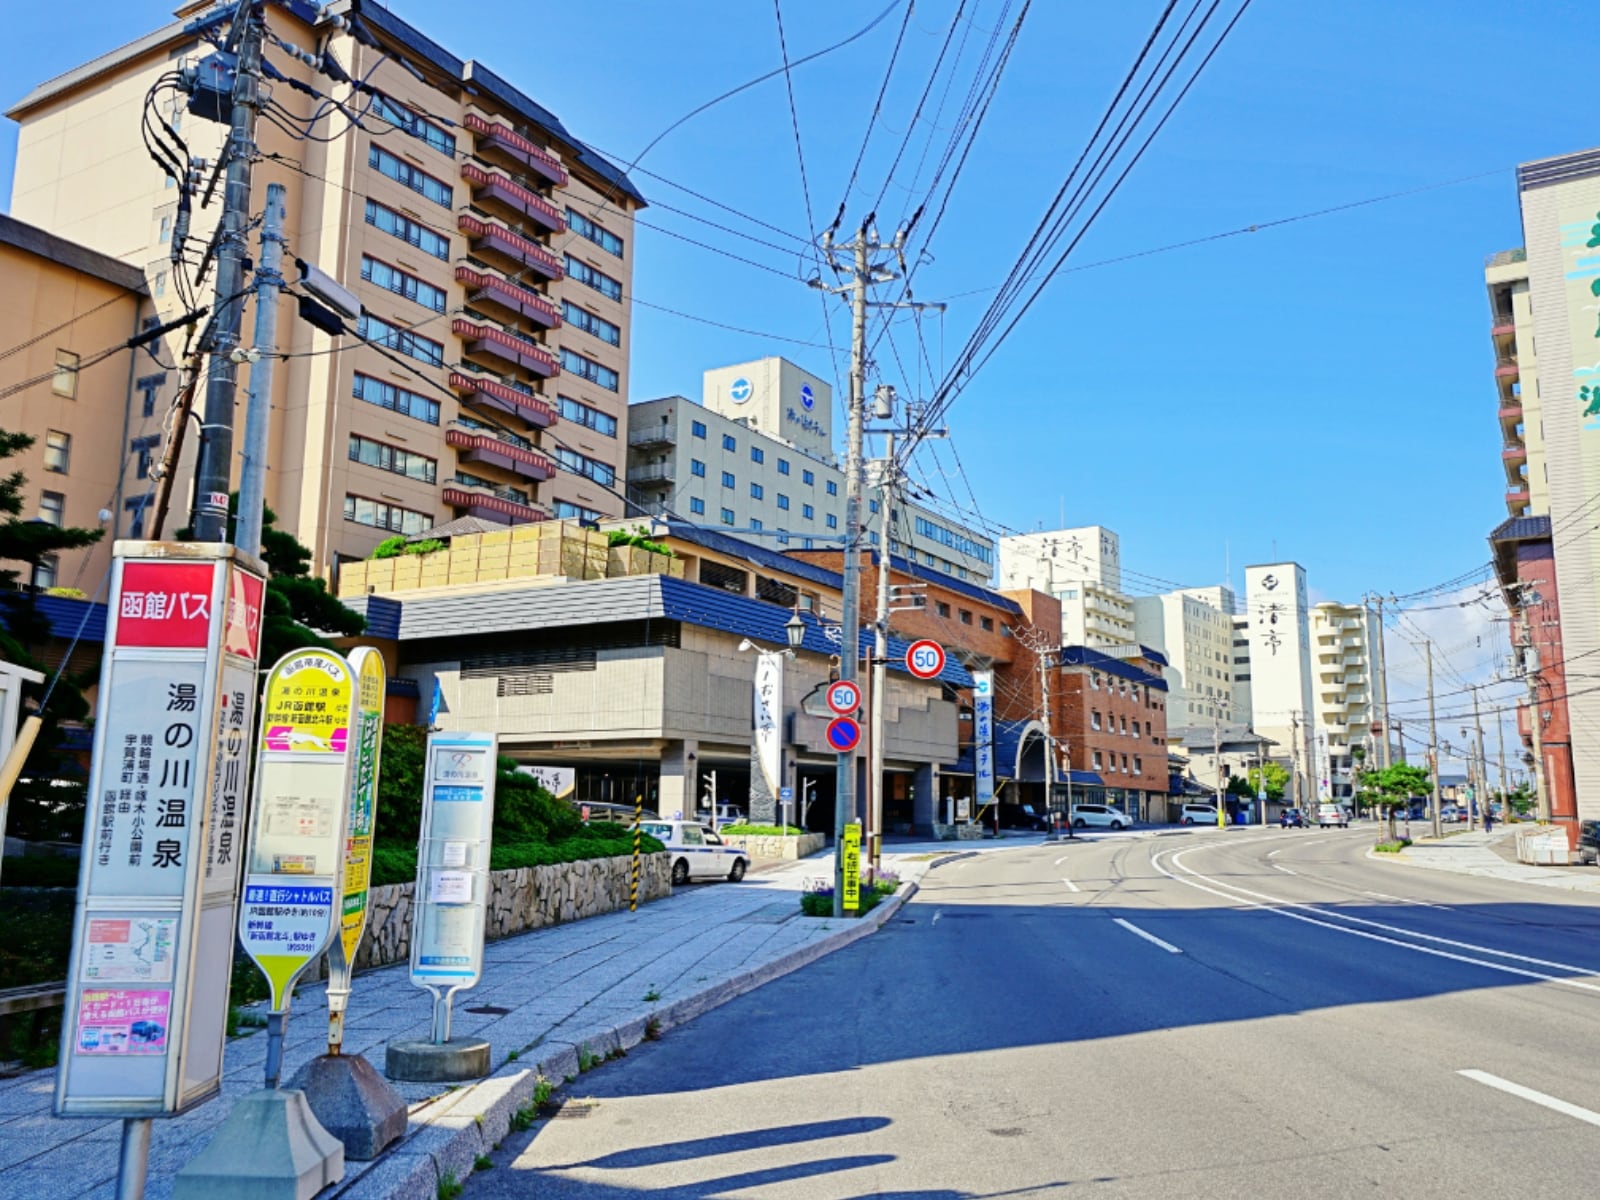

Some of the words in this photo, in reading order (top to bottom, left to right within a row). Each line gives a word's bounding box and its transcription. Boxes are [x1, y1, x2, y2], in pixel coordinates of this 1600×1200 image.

[121, 591, 209, 620] 函館バス
[915, 651, 936, 667] 50
[834, 690, 853, 705] 50
[152, 683, 197, 868] 湯の川温泉
[217, 689, 245, 865] 湯の川温泉
